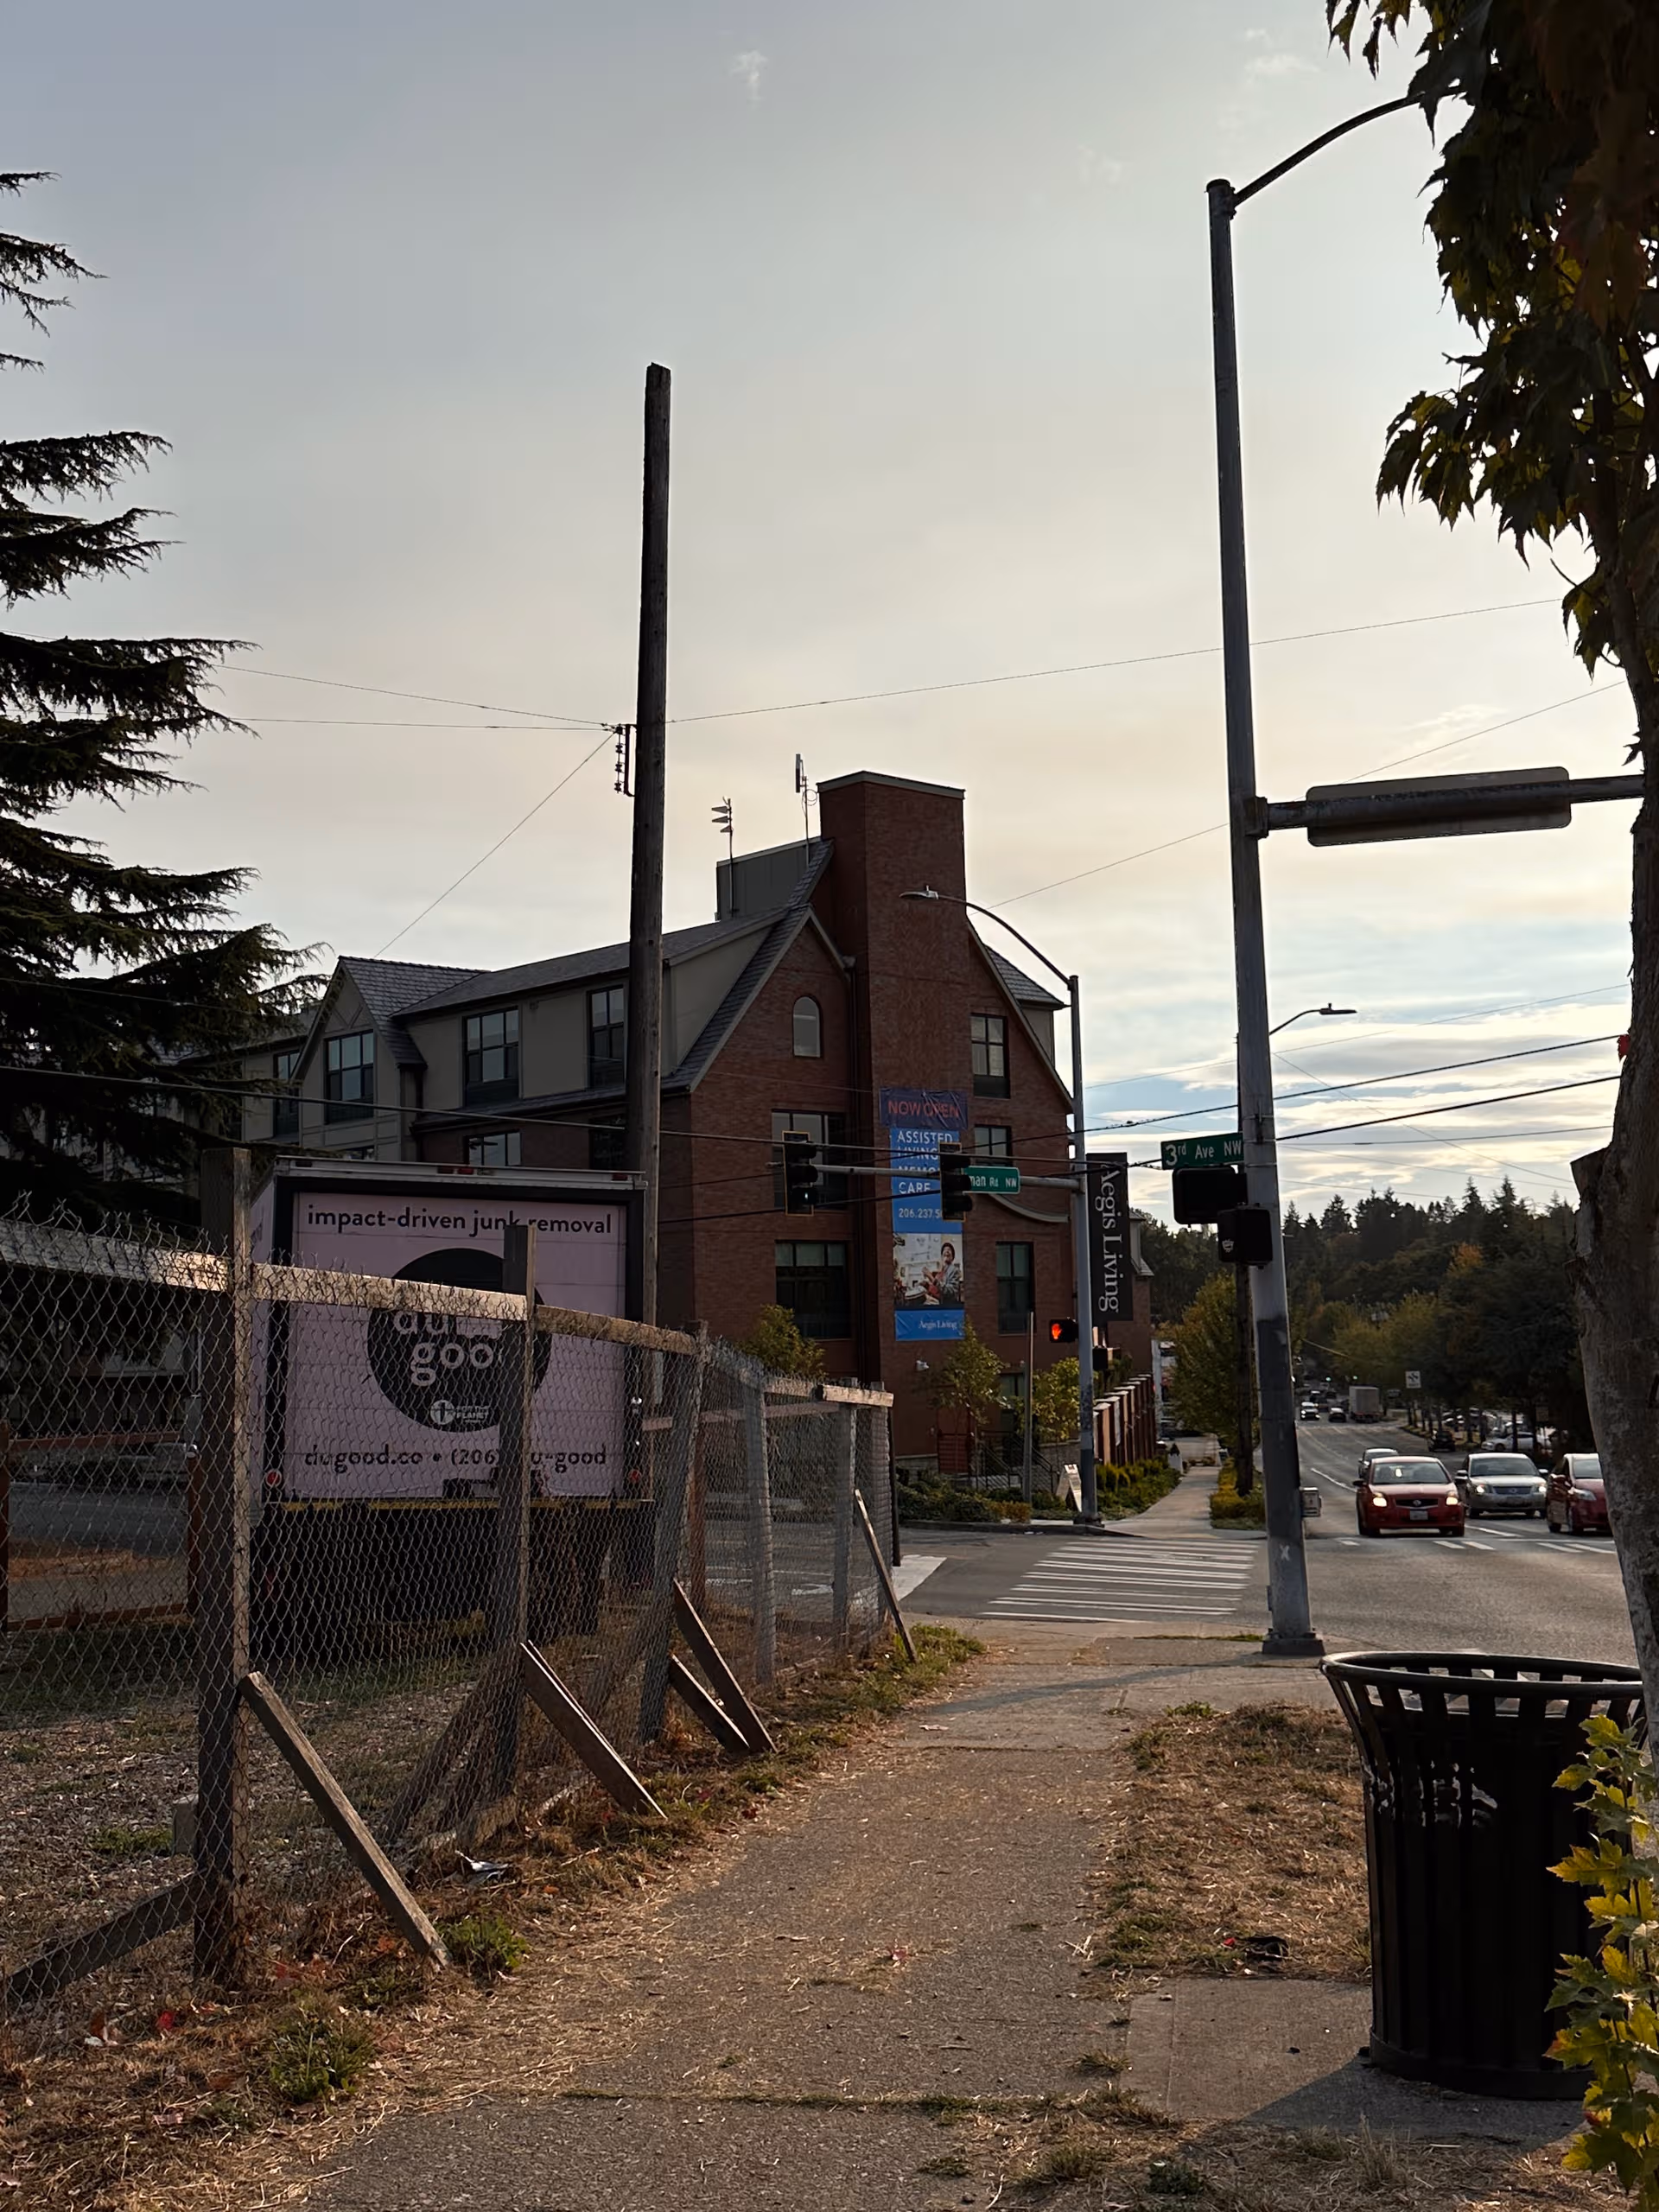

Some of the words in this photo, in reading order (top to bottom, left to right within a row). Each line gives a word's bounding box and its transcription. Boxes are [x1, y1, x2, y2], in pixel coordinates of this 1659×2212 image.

[887, 1100, 921, 1116] NOW
[924, 1102, 960, 1118] OPEN
[897, 1130, 953, 1144] ASSISTED
[898, 1147, 939, 1160] LIVING
[1165, 1142, 1187, 1166] 3rd
[1195, 1144, 1215, 1160] Ave
[1224, 1139, 1242, 1156] NW
[899, 1181, 931, 1194] CARE
[969, 1174, 986, 1187] man
[989, 1176, 1000, 1187] Rd
[1005, 1177, 1017, 1188] NW
[1095, 1164, 1123, 1229] Aegis
[308, 1205, 466, 1233] impact-driven
[469, 1210, 520, 1236] junk
[528, 1214, 612, 1234] removal
[899, 1207, 944, 1219] 206.237.5
[1098, 1233, 1124, 1313] Living
[918, 1320, 937, 1331] Aegis
[938, 1319, 957, 1331] Living
[410, 1342, 502, 1387] goo
